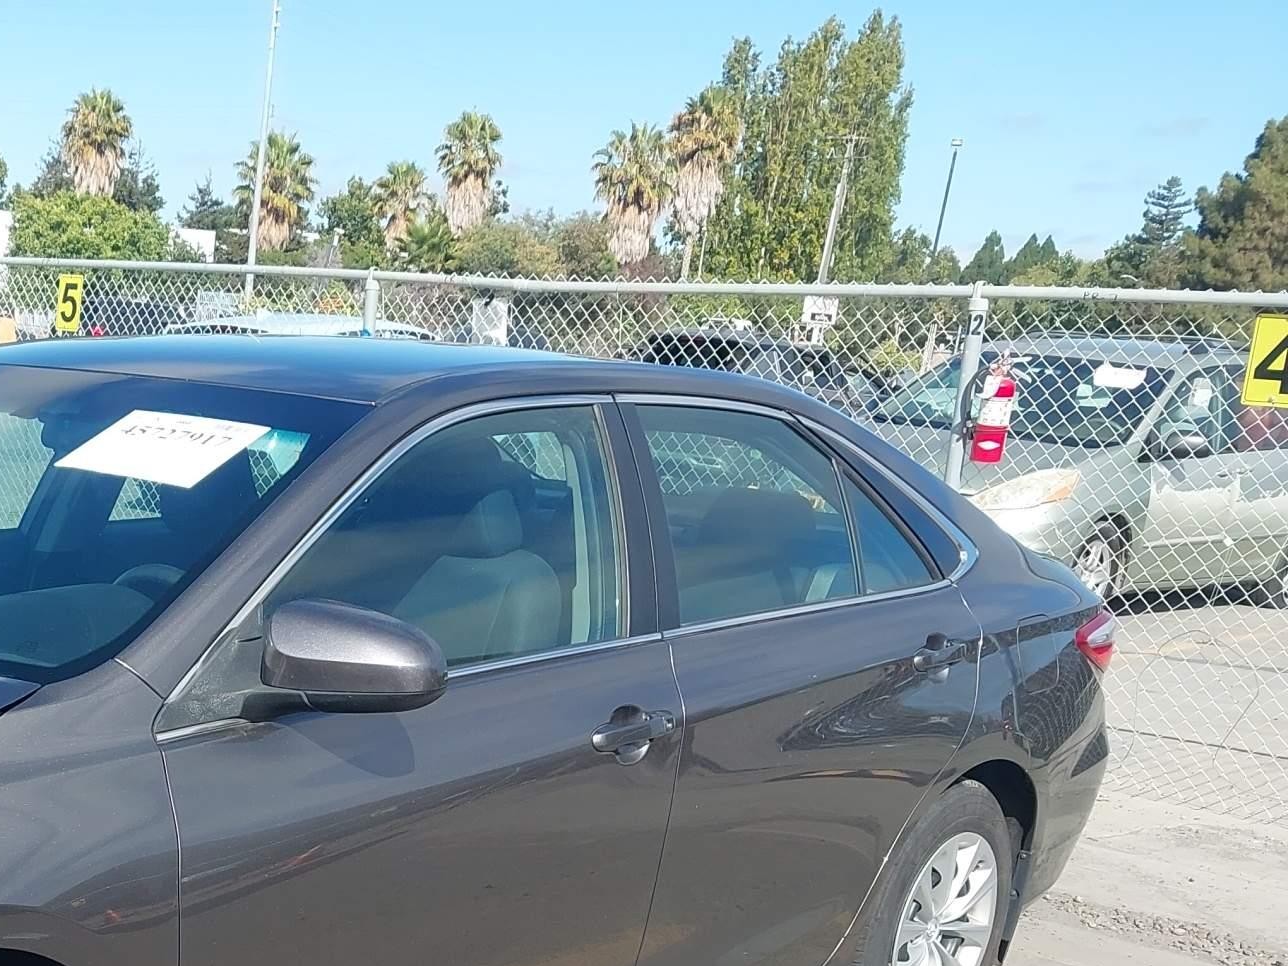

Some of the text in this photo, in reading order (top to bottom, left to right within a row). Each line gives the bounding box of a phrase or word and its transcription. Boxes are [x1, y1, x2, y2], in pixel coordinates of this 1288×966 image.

[61, 283, 78, 322] 5
[967, 313, 984, 336] 12
[1253, 335, 1288, 395] 4
